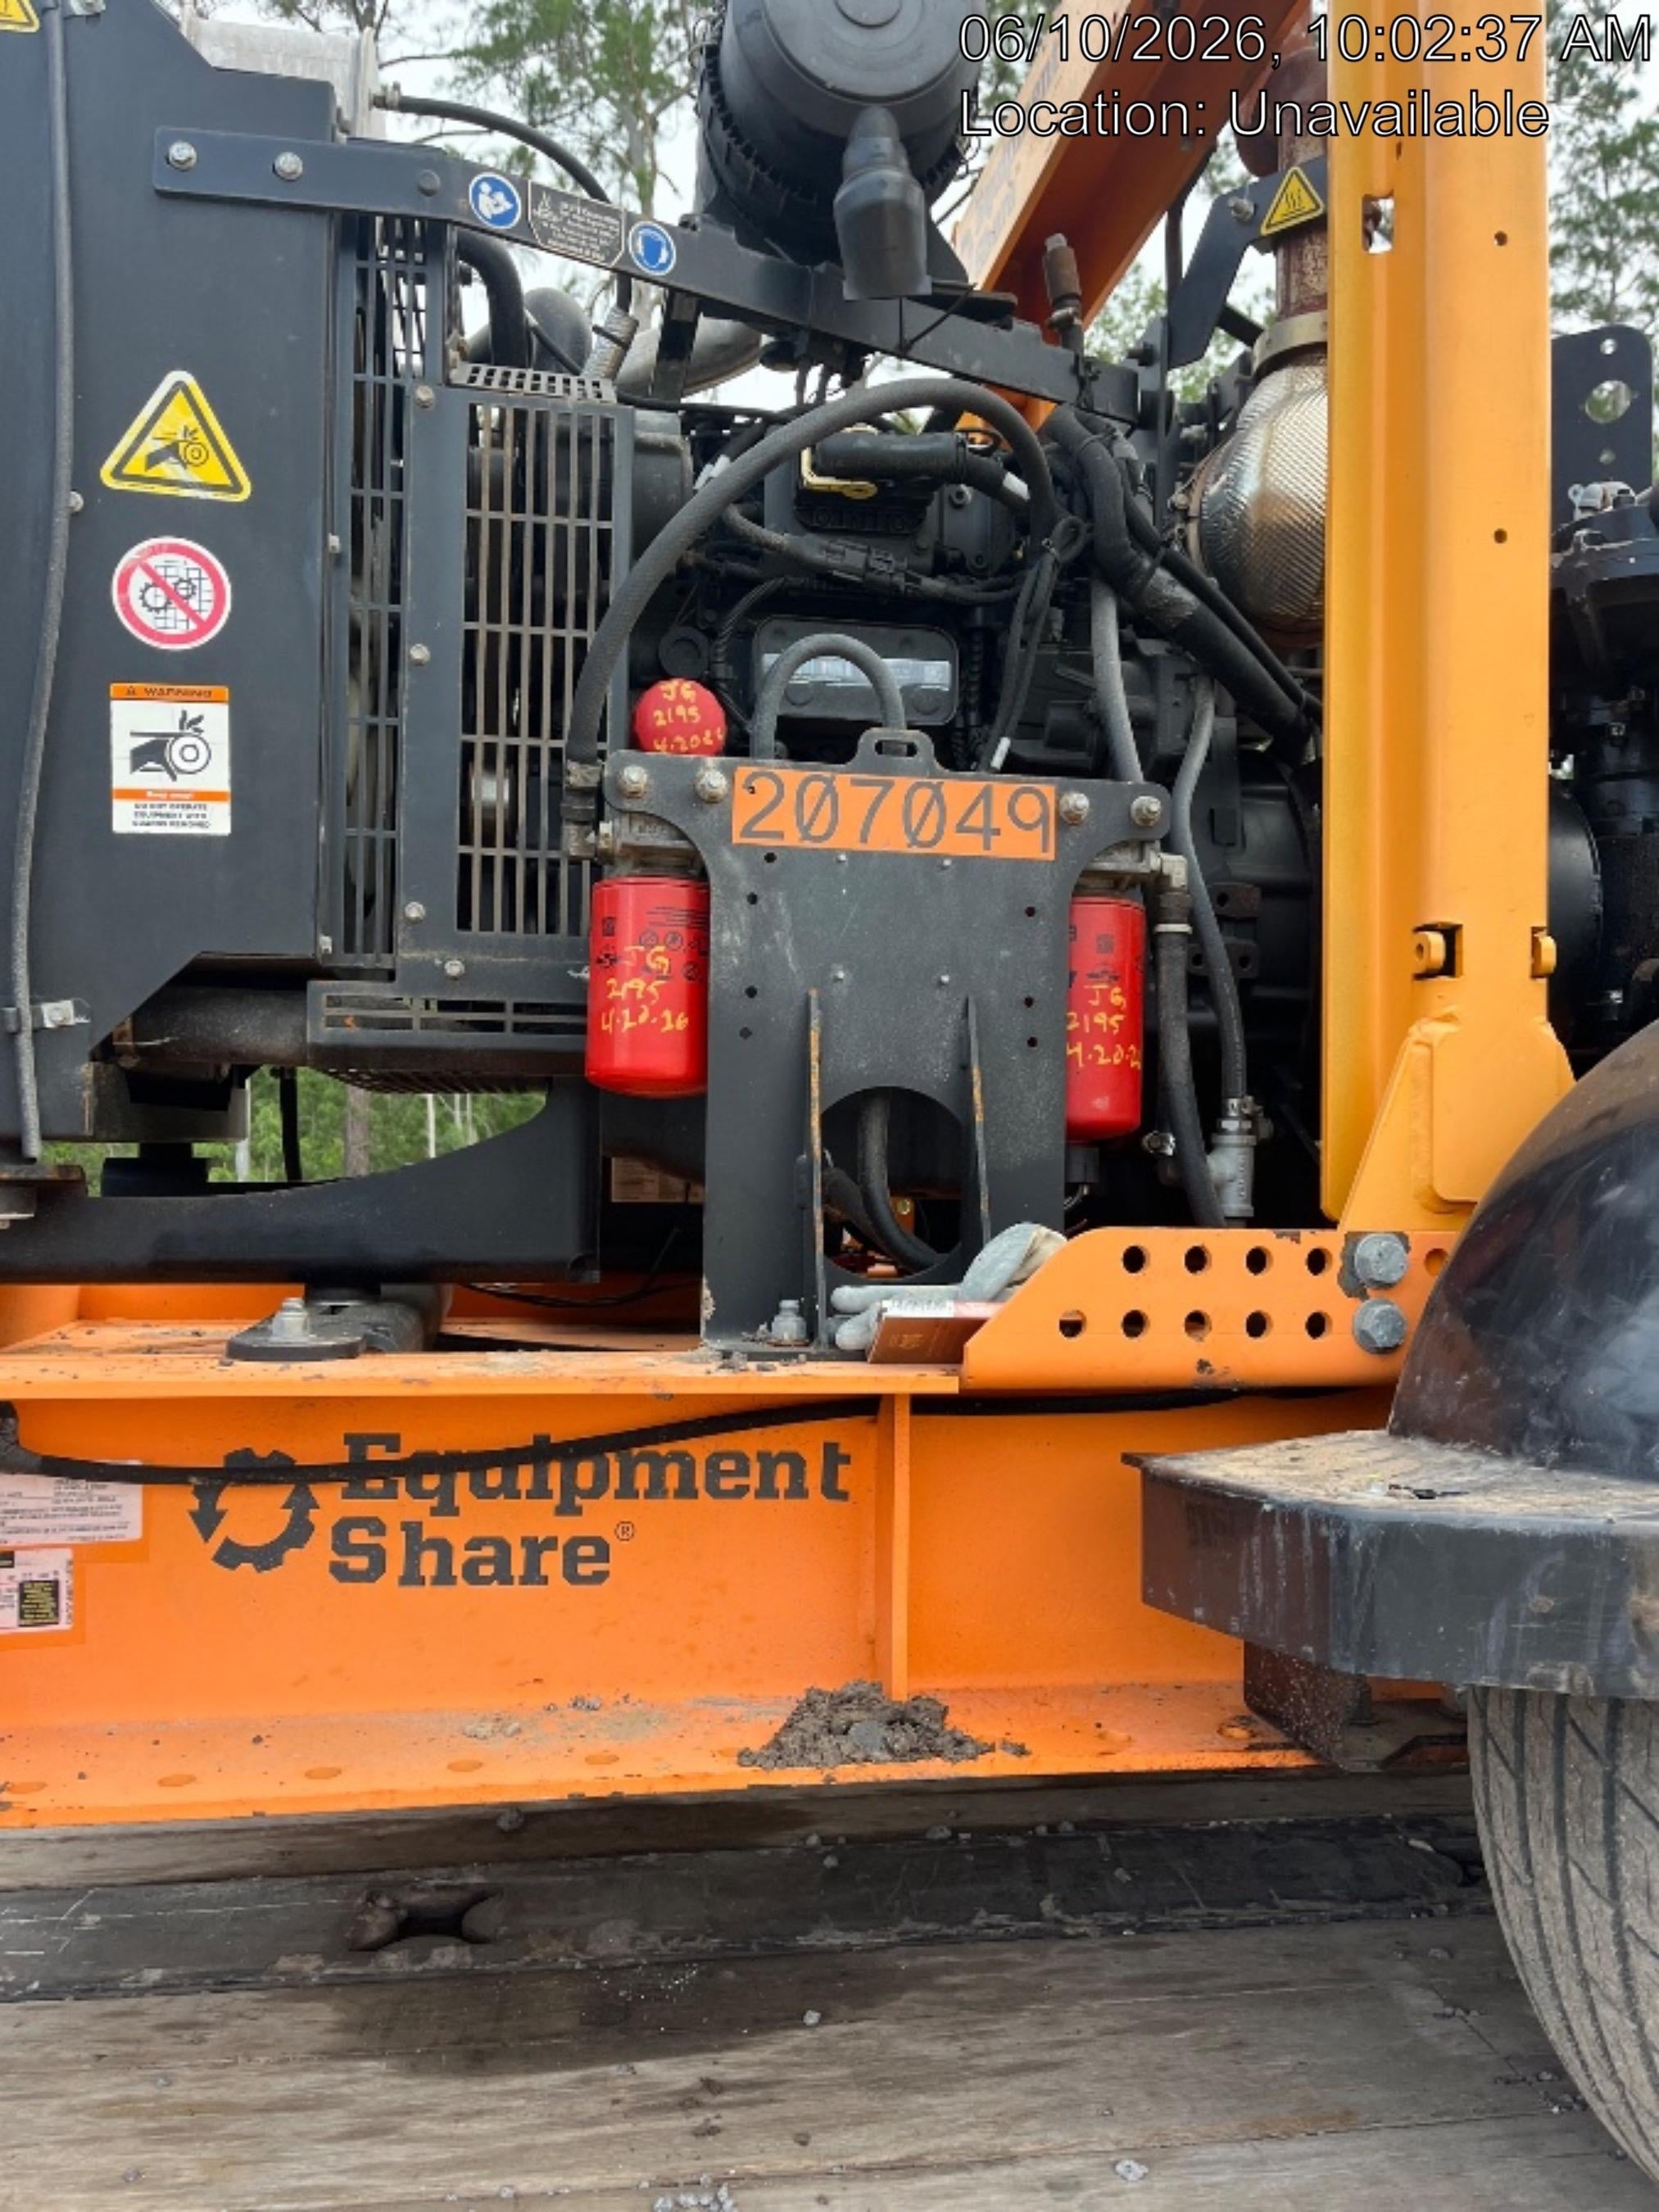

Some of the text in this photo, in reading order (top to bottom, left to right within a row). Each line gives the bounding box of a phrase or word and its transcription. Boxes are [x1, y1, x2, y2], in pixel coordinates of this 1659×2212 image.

[654, 705, 701, 726] 2195
[740, 770, 1049, 854] 207049
[1067, 1012, 1126, 1035] 2195
[342, 1433, 851, 1516] Equipment
